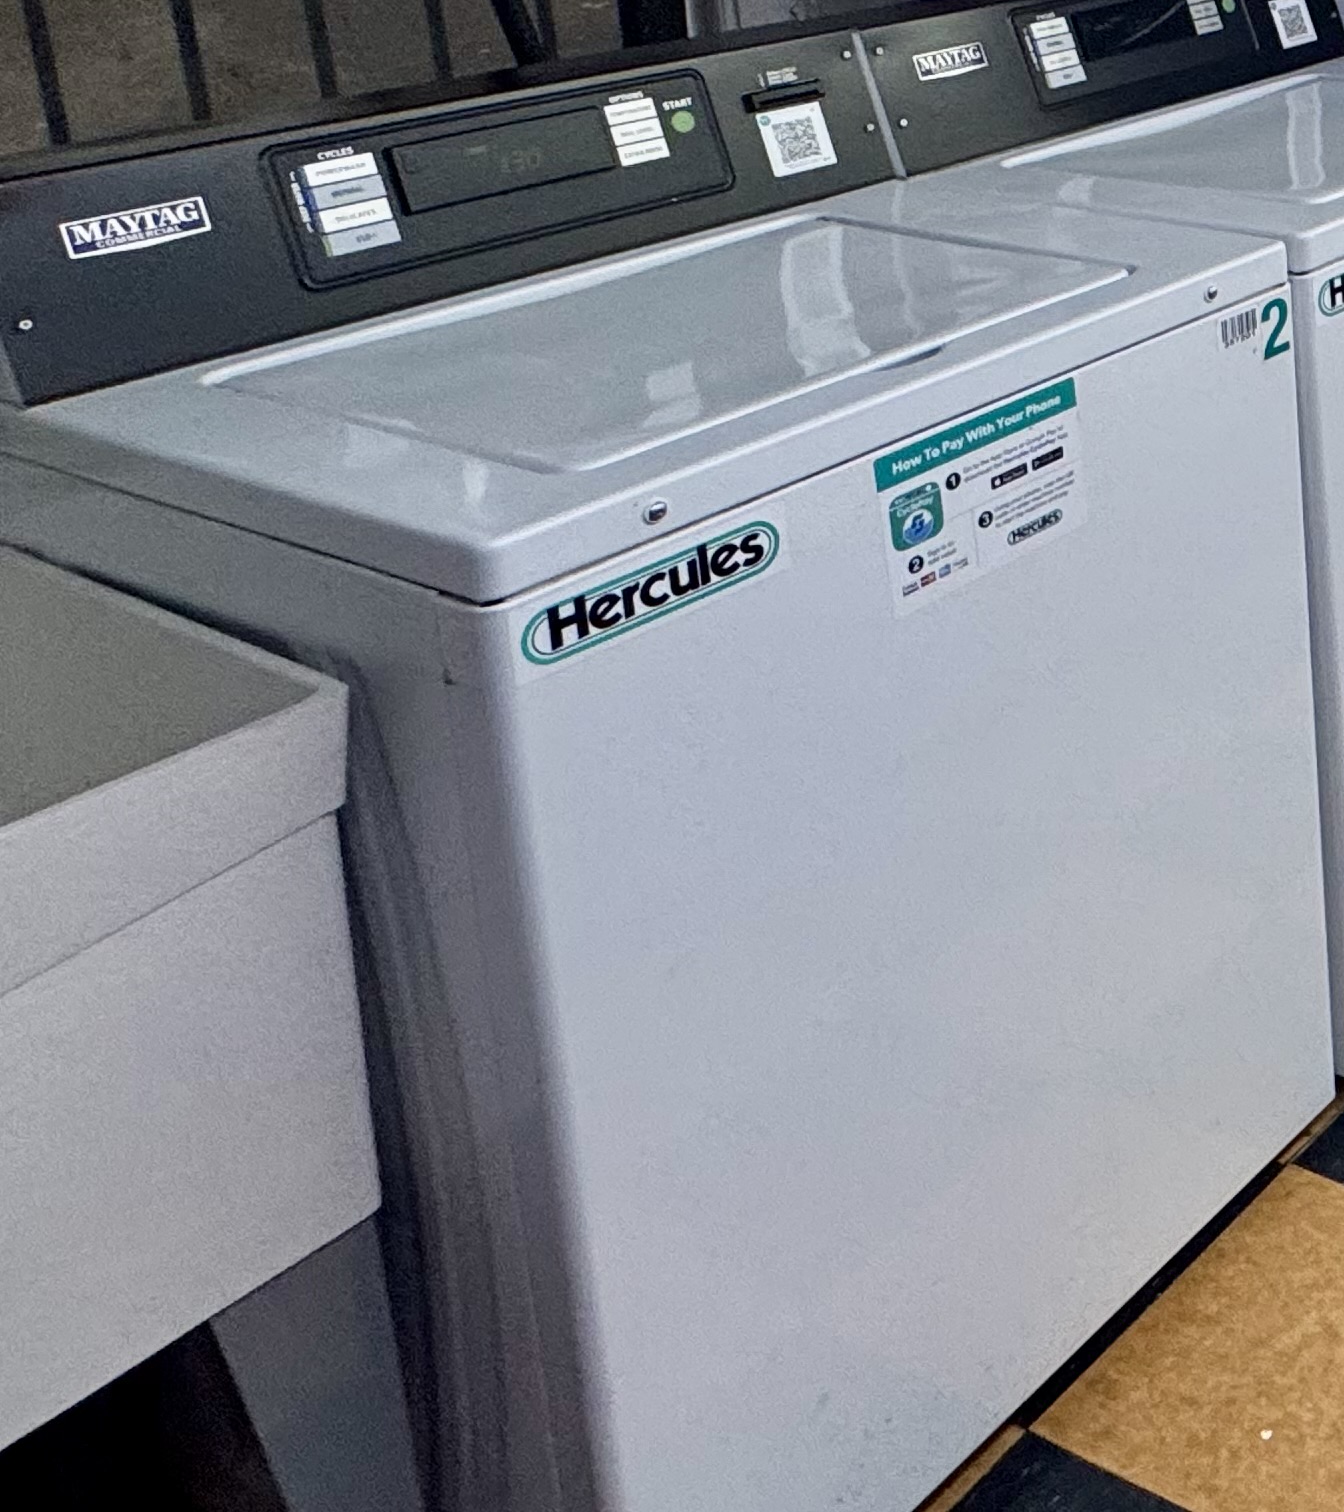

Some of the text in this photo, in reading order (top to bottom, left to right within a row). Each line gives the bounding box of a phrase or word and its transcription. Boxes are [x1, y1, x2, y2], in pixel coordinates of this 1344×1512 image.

[918, 46, 981, 71] MAYTAG
[662, 97, 692, 110] START
[317, 146, 354, 161] CYCLES
[69, 203, 200, 245] MAYTAG
[96, 225, 182, 249] COMMERCIAL
[1261, 298, 1290, 361] 2
[892, 396, 1061, 476] How To Pay With Your Phone
[1012, 510, 1060, 544] Hercules
[547, 532, 764, 651] Hercules
